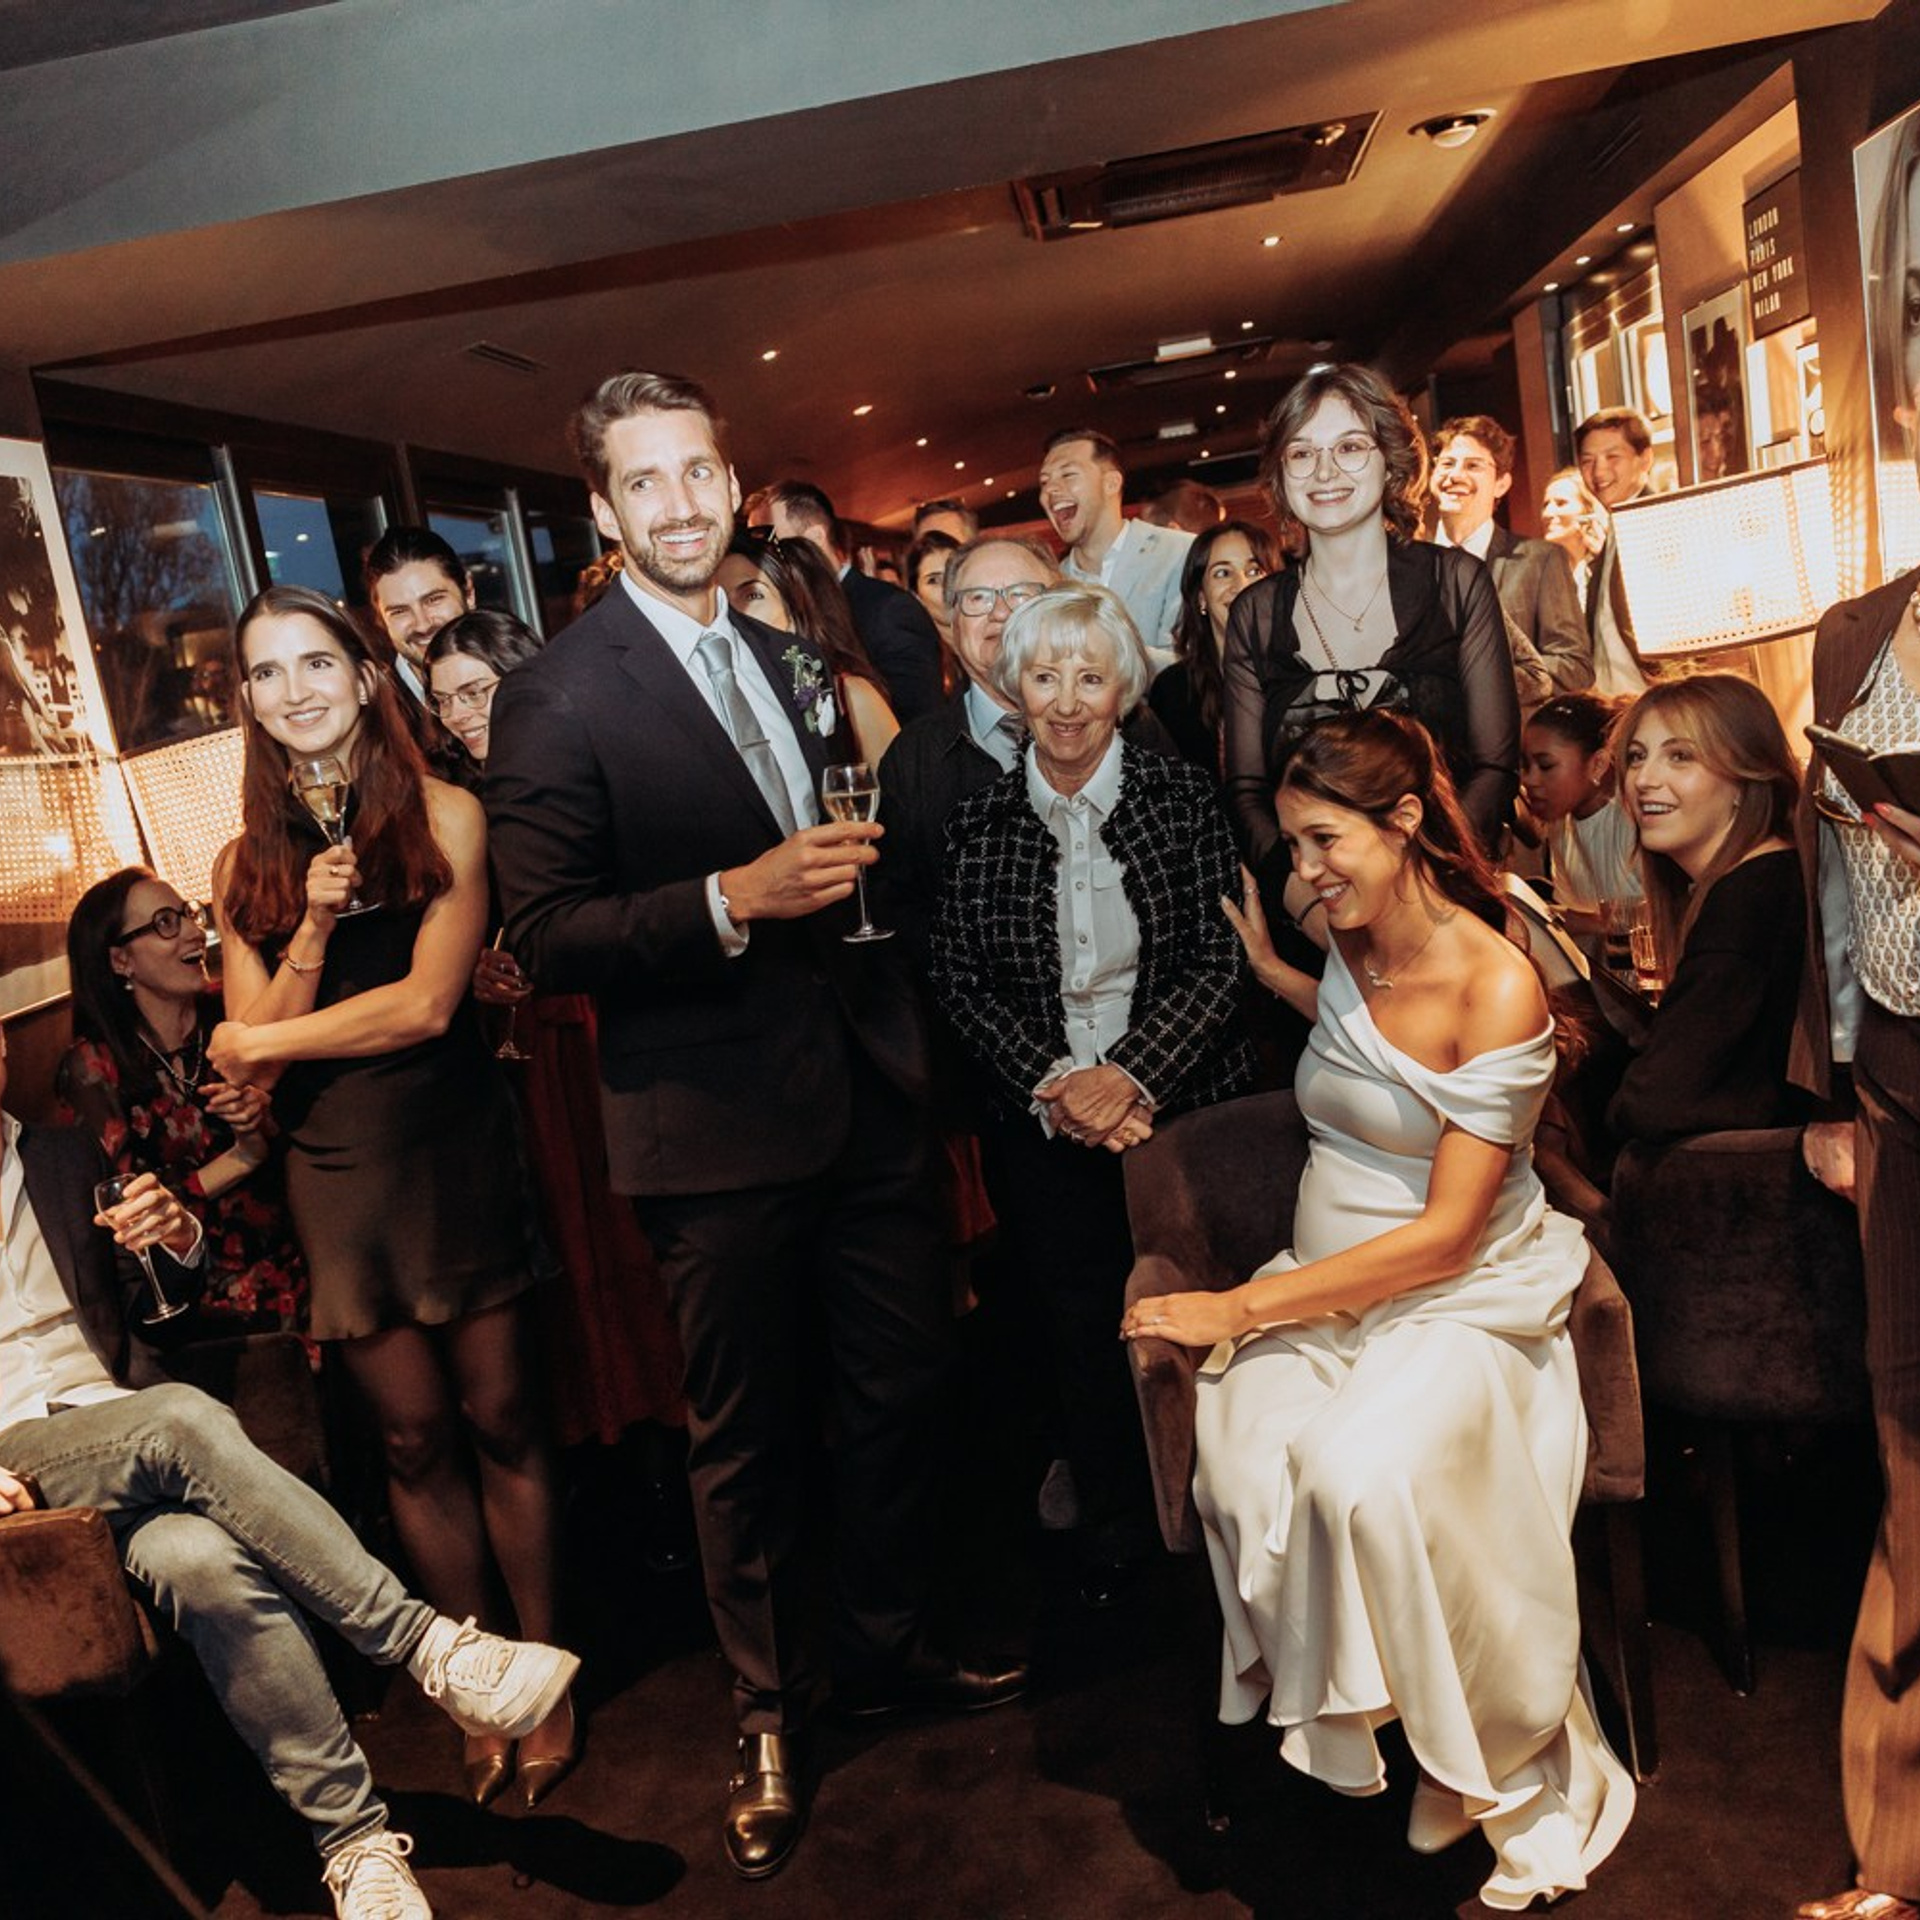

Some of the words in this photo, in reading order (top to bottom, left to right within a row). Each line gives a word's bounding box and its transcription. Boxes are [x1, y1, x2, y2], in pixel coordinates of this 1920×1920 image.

[1750, 238, 1775, 266] PARIS
[1753, 270, 1768, 293] NEW
[1772, 256, 1794, 283] YORK
